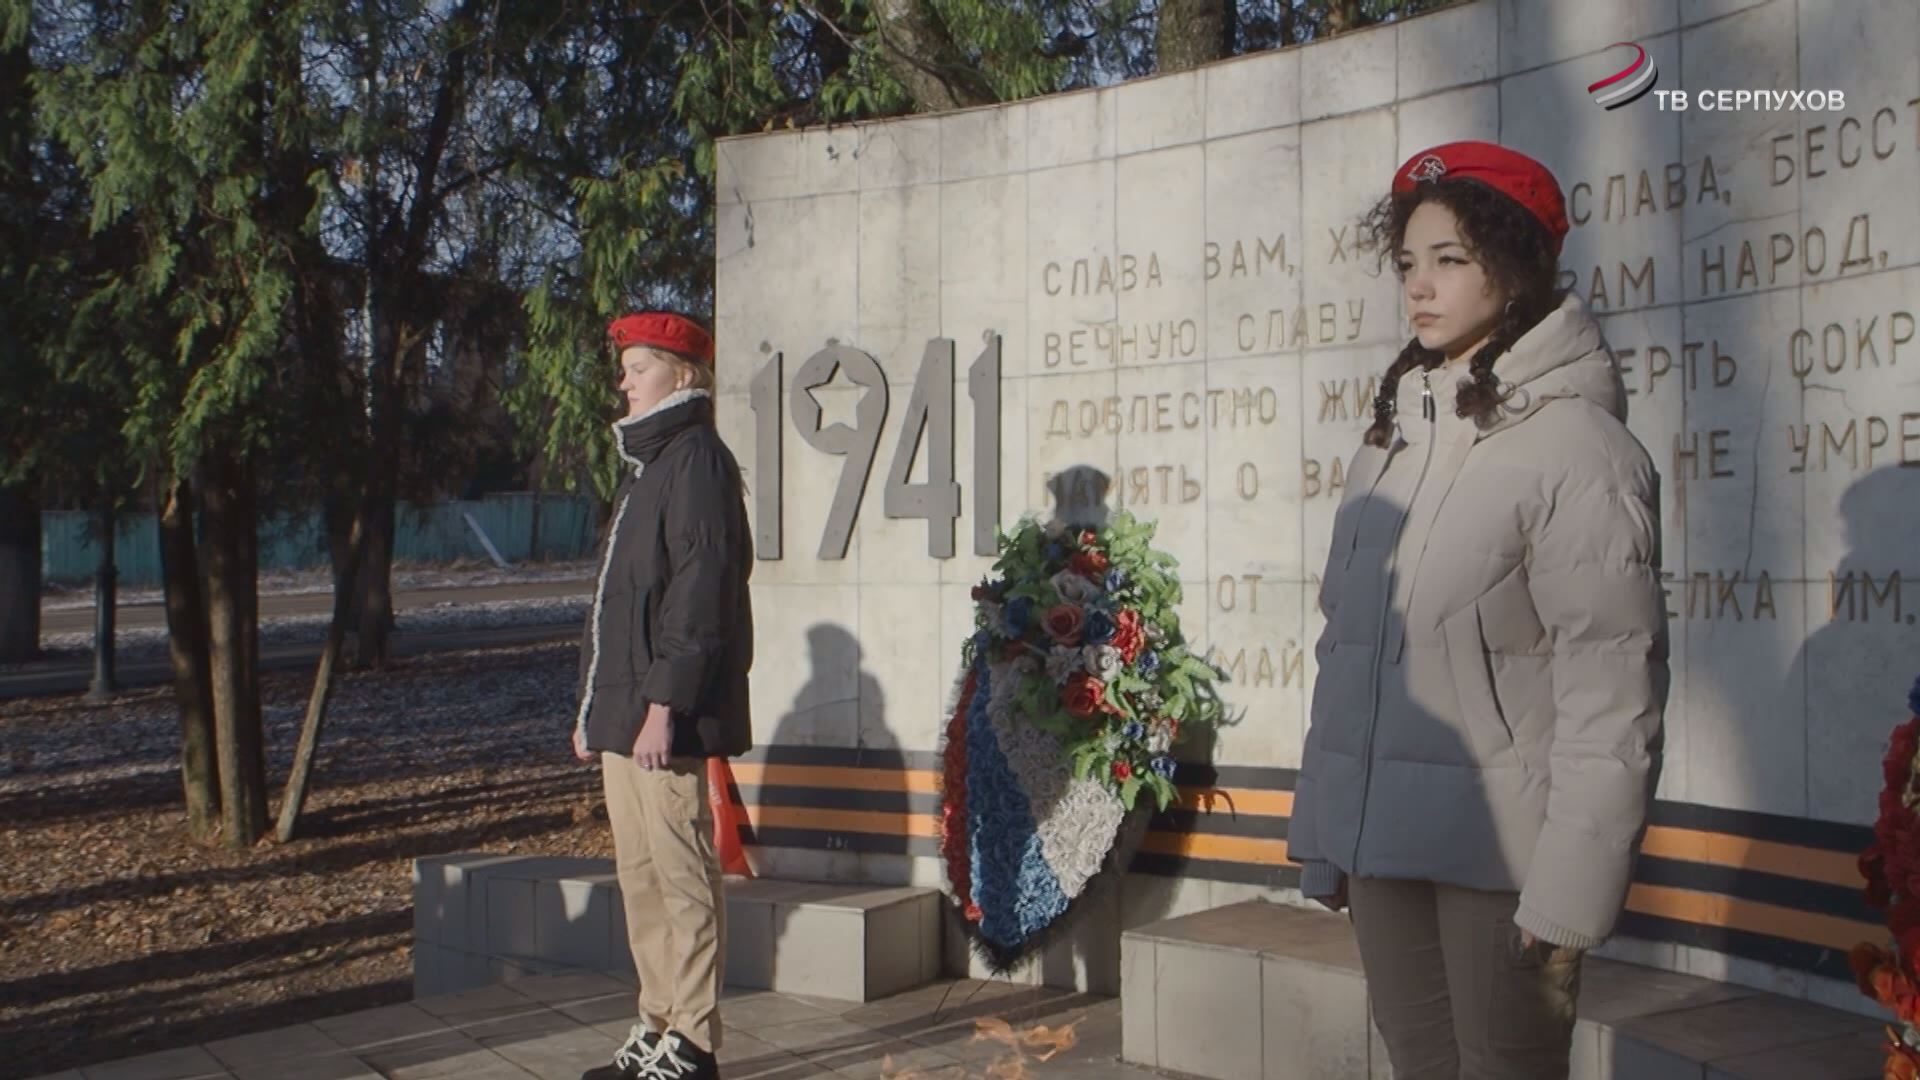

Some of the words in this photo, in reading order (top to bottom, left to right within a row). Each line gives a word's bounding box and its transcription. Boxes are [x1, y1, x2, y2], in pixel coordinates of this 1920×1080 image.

[1043, 251, 1163, 297] СЛАВА
[1203, 232, 1295, 280] ВАМ,
[1570, 155, 1732, 226] СЛАВА,
[1044, 318, 1197, 368] ВЕЧНУЮ
[1237, 298, 1365, 352] СЛАВУ
[1045, 386, 1277, 440] ДОБЛЕСТНО
[1790, 311, 1916, 379] СОКР
[750, 332, 1003, 561] 1941
[1236, 461, 1259, 502] О
[1673, 430, 1735, 481] НЕ
[1789, 412, 1920, 474] УМРЕ
[1217, 574, 1263, 613] ОТ
[1827, 569, 1917, 626] ИМ.
